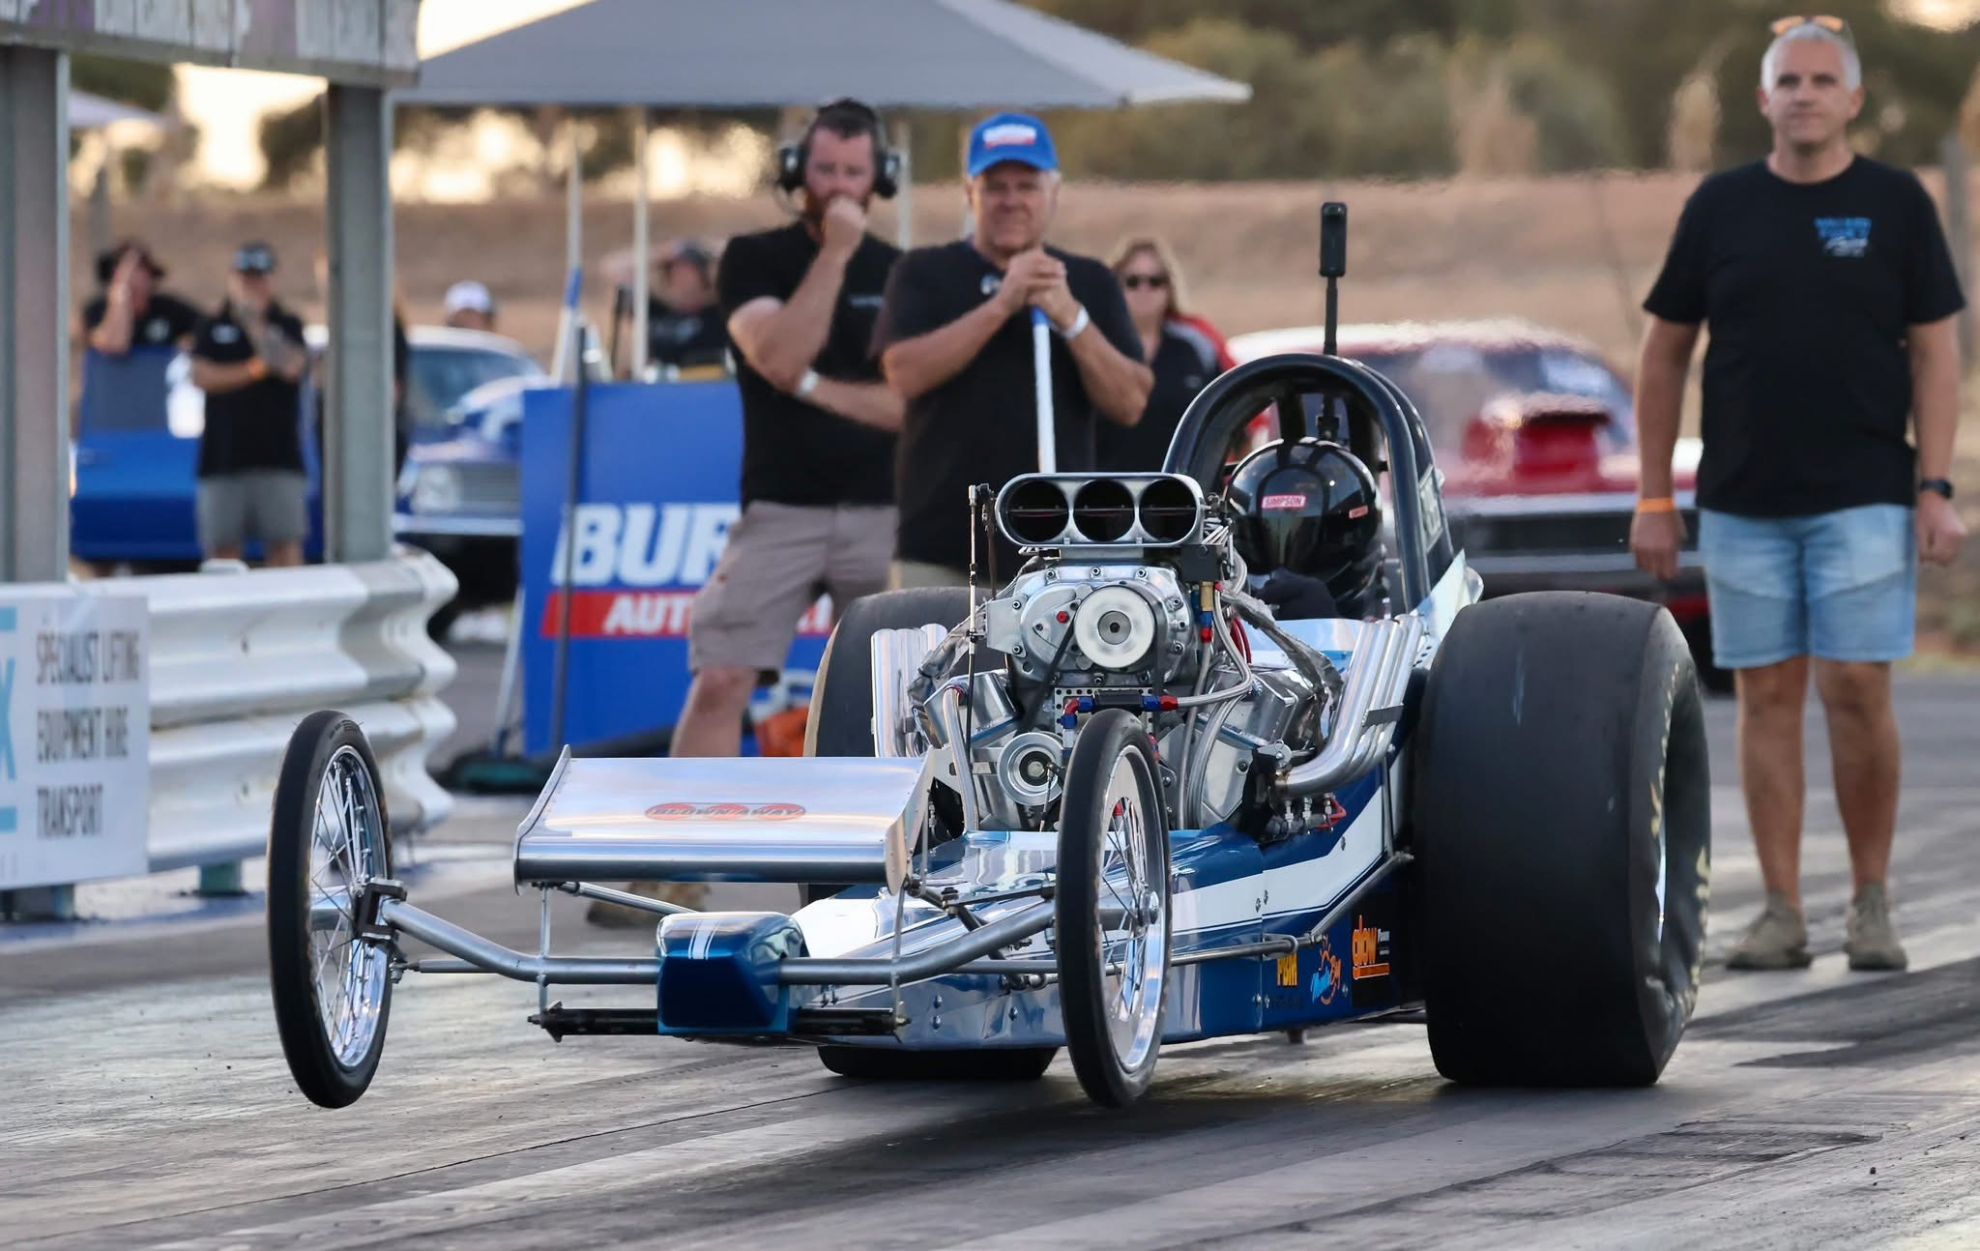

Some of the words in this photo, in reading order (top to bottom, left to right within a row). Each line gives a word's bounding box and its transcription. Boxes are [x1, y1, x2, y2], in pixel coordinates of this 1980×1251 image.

[1264, 496, 1303, 507] SIMPSON
[36, 631, 99, 684] SPECIALIST
[102, 629, 140, 682] LIFTING
[36, 707, 101, 762] EQUIPMENT
[105, 706, 129, 758] HIRE
[36, 783, 103, 839] TRANSPORT
